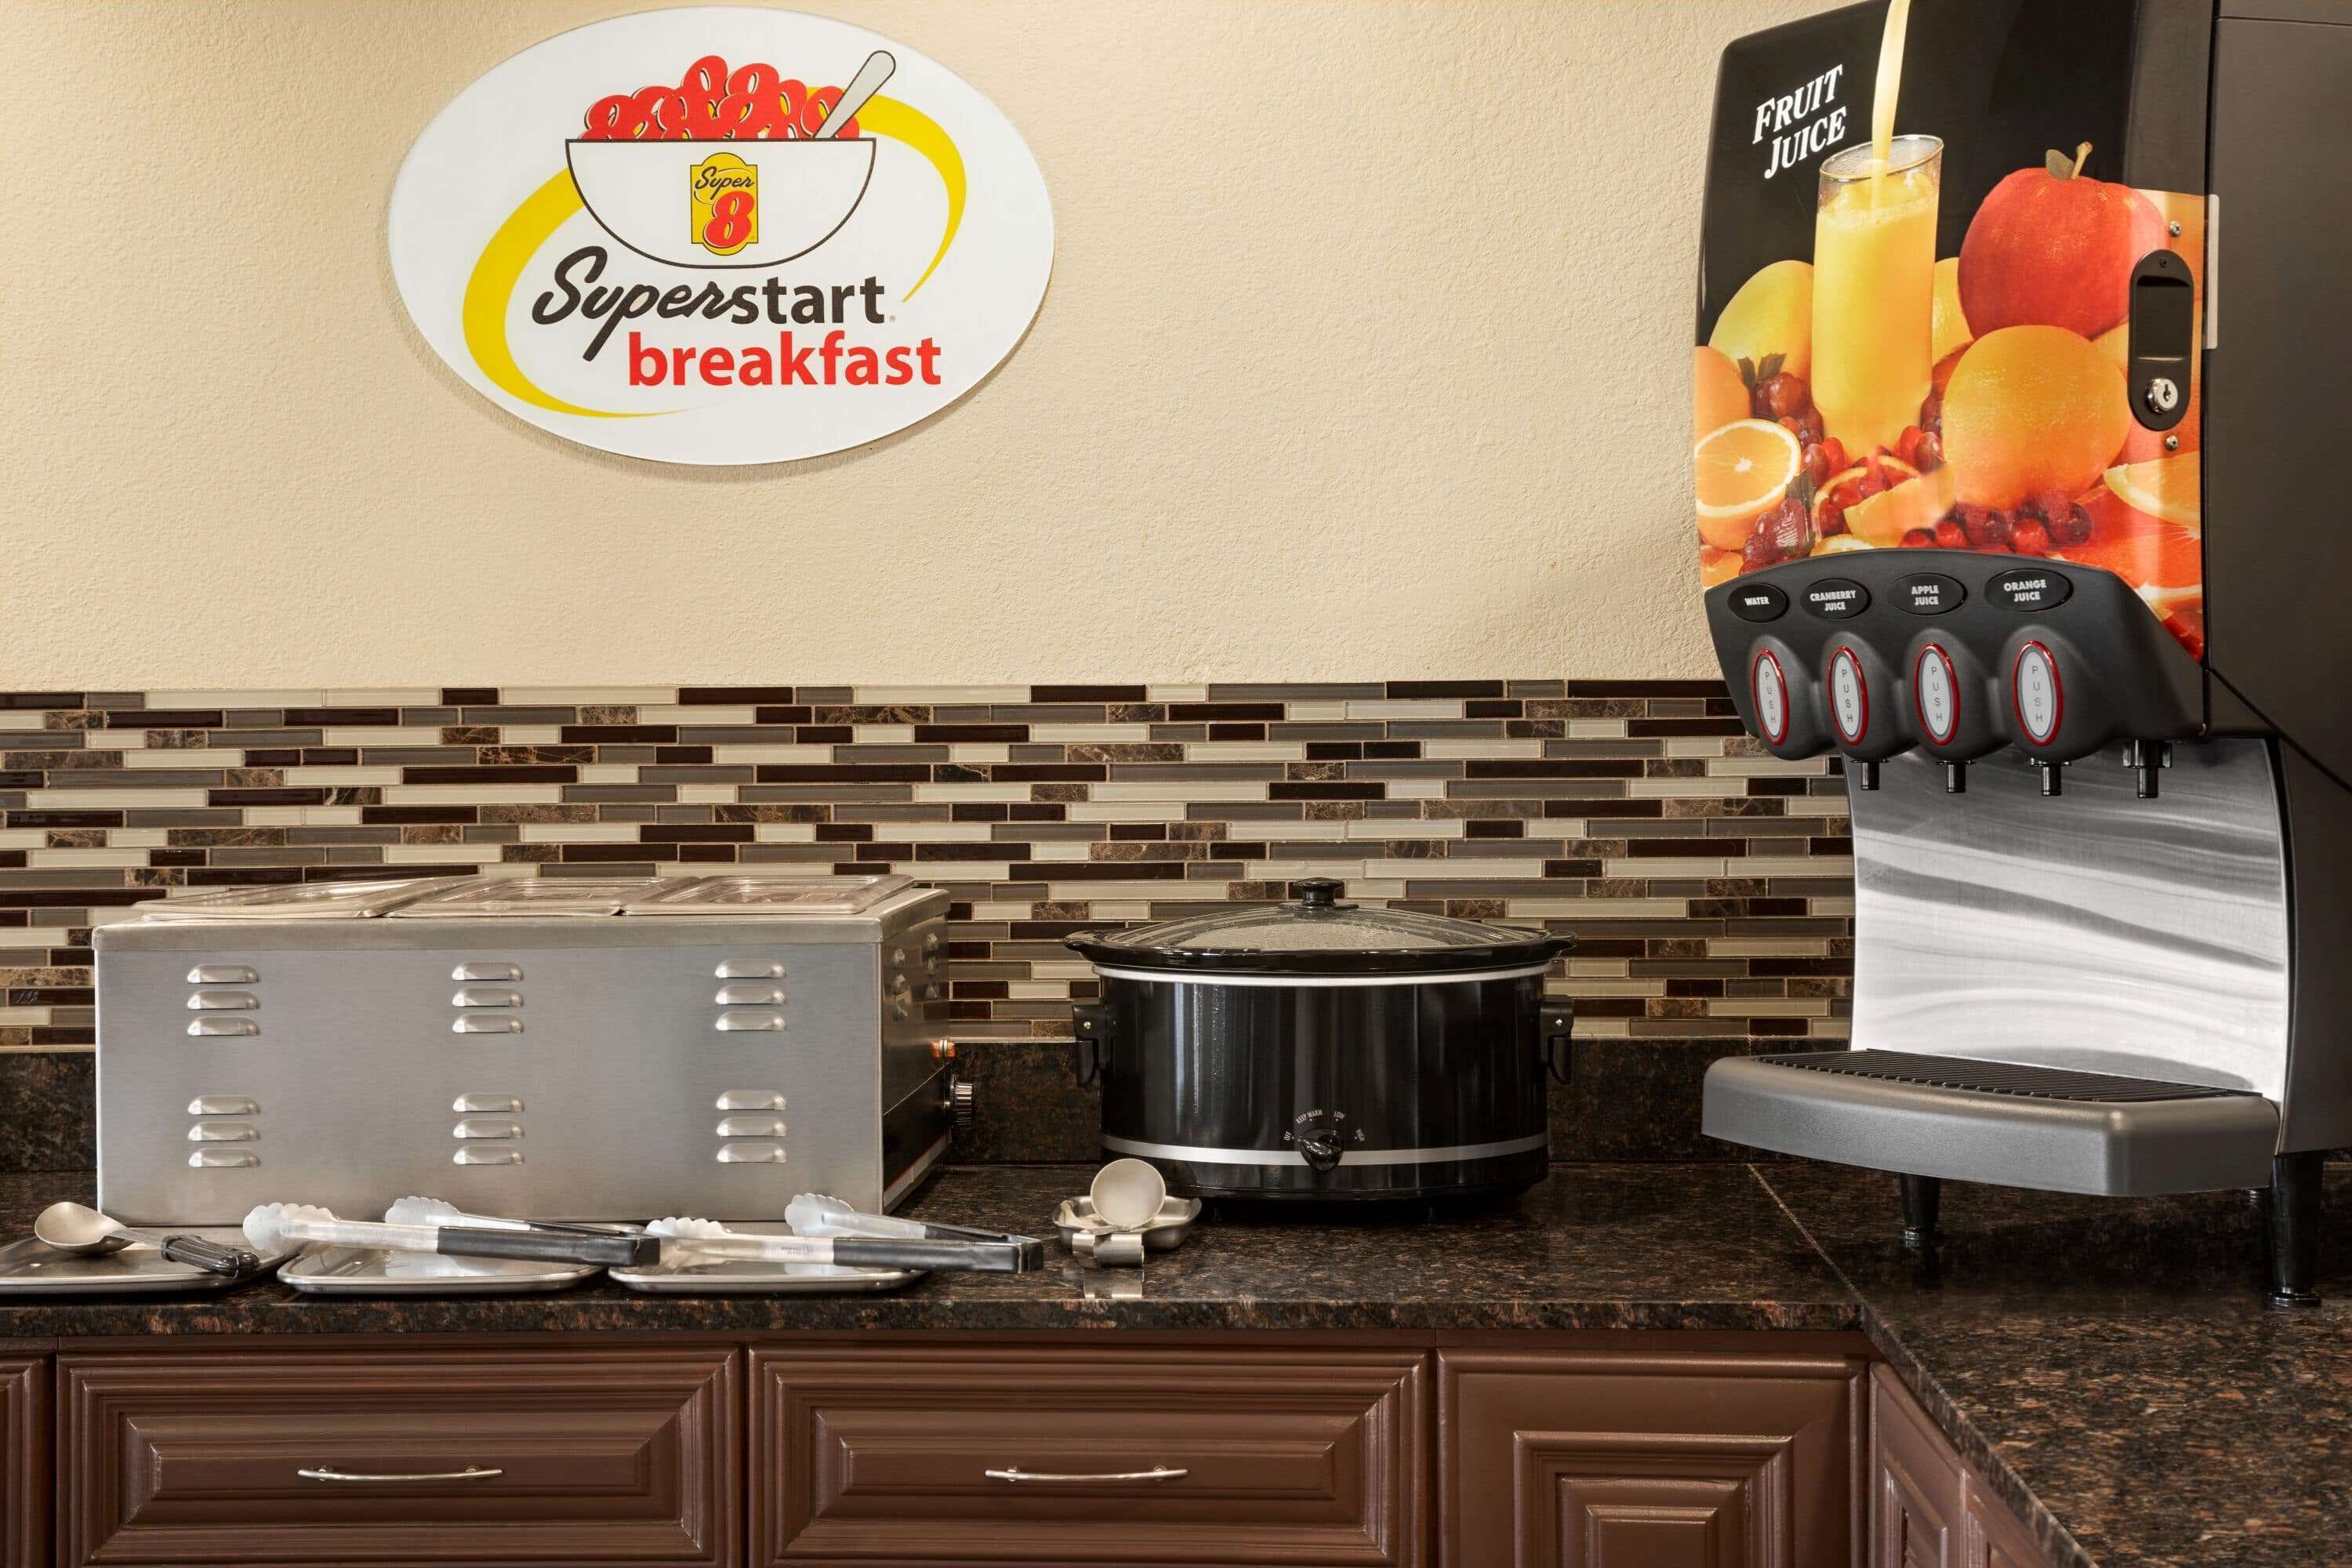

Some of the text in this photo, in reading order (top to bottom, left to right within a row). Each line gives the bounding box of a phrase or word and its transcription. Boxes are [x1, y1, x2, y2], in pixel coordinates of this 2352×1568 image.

[1752, 64, 1843, 144] FRUIT
[1764, 106, 1846, 180] JUICE
[695, 165, 755, 200] Super
[702, 190, 755, 249] 8
[629, 329, 942, 387] breakfast
[1911, 585, 1940, 595] APPLE
[2003, 579, 2047, 592] ORANGE
[1744, 596, 1769, 606] WATER
[1809, 590, 1857, 602] CRANBERRY
[1914, 596, 1940, 606] JUICE
[2013, 591, 2041, 602] JUICE
[1824, 601, 1846, 612] JUICE
[1764, 671, 1777, 723] PUSH
[1841, 669, 1853, 723] PUSH
[1931, 666, 1944, 723] PUSH
[2031, 666, 2044, 723] PUSH
[1296, 1109, 1323, 1123] KEEP WARM
[1334, 1111, 1345, 1120] LOW
[1283, 1131, 1293, 1141] OFF
